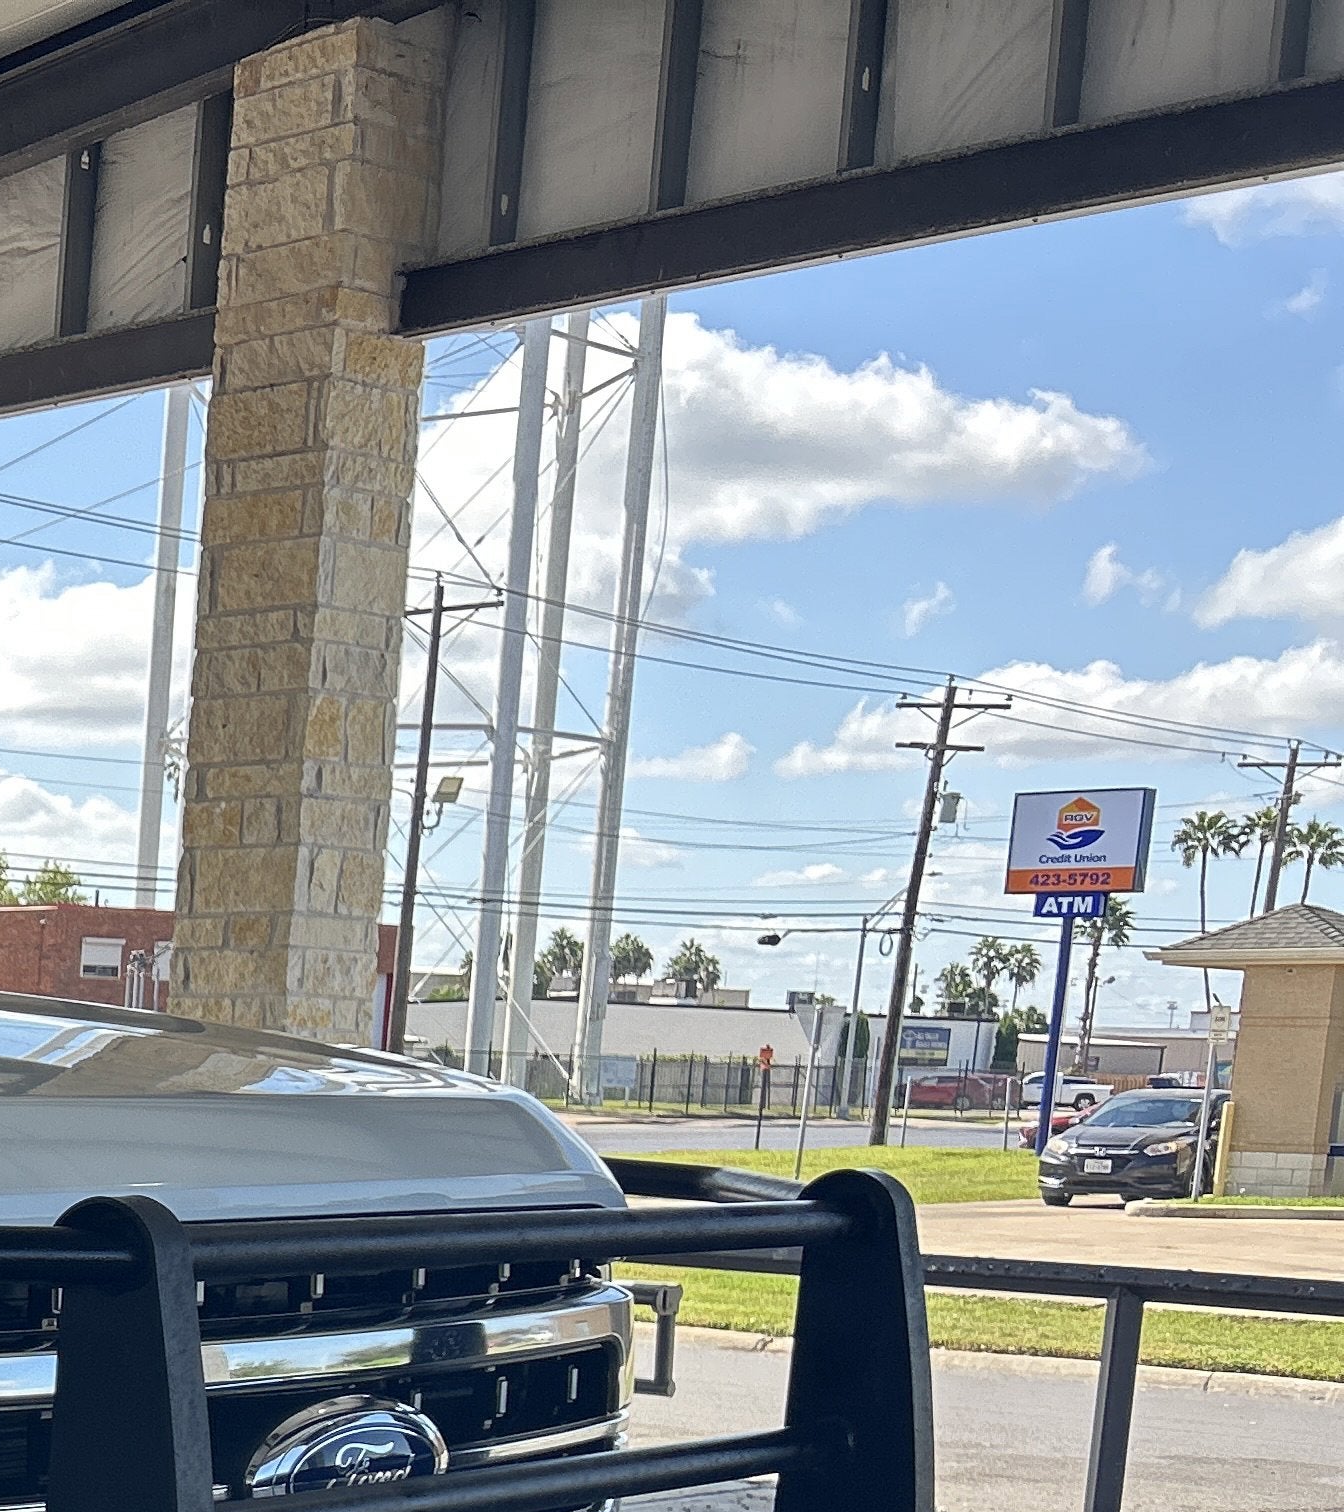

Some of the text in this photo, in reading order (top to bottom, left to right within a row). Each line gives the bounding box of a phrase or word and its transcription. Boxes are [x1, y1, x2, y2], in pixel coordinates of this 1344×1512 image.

[1038, 852, 1107, 864] Credit Union
[1029, 872, 1111, 886] 423-5792
[1041, 897, 1093, 914] ATM
